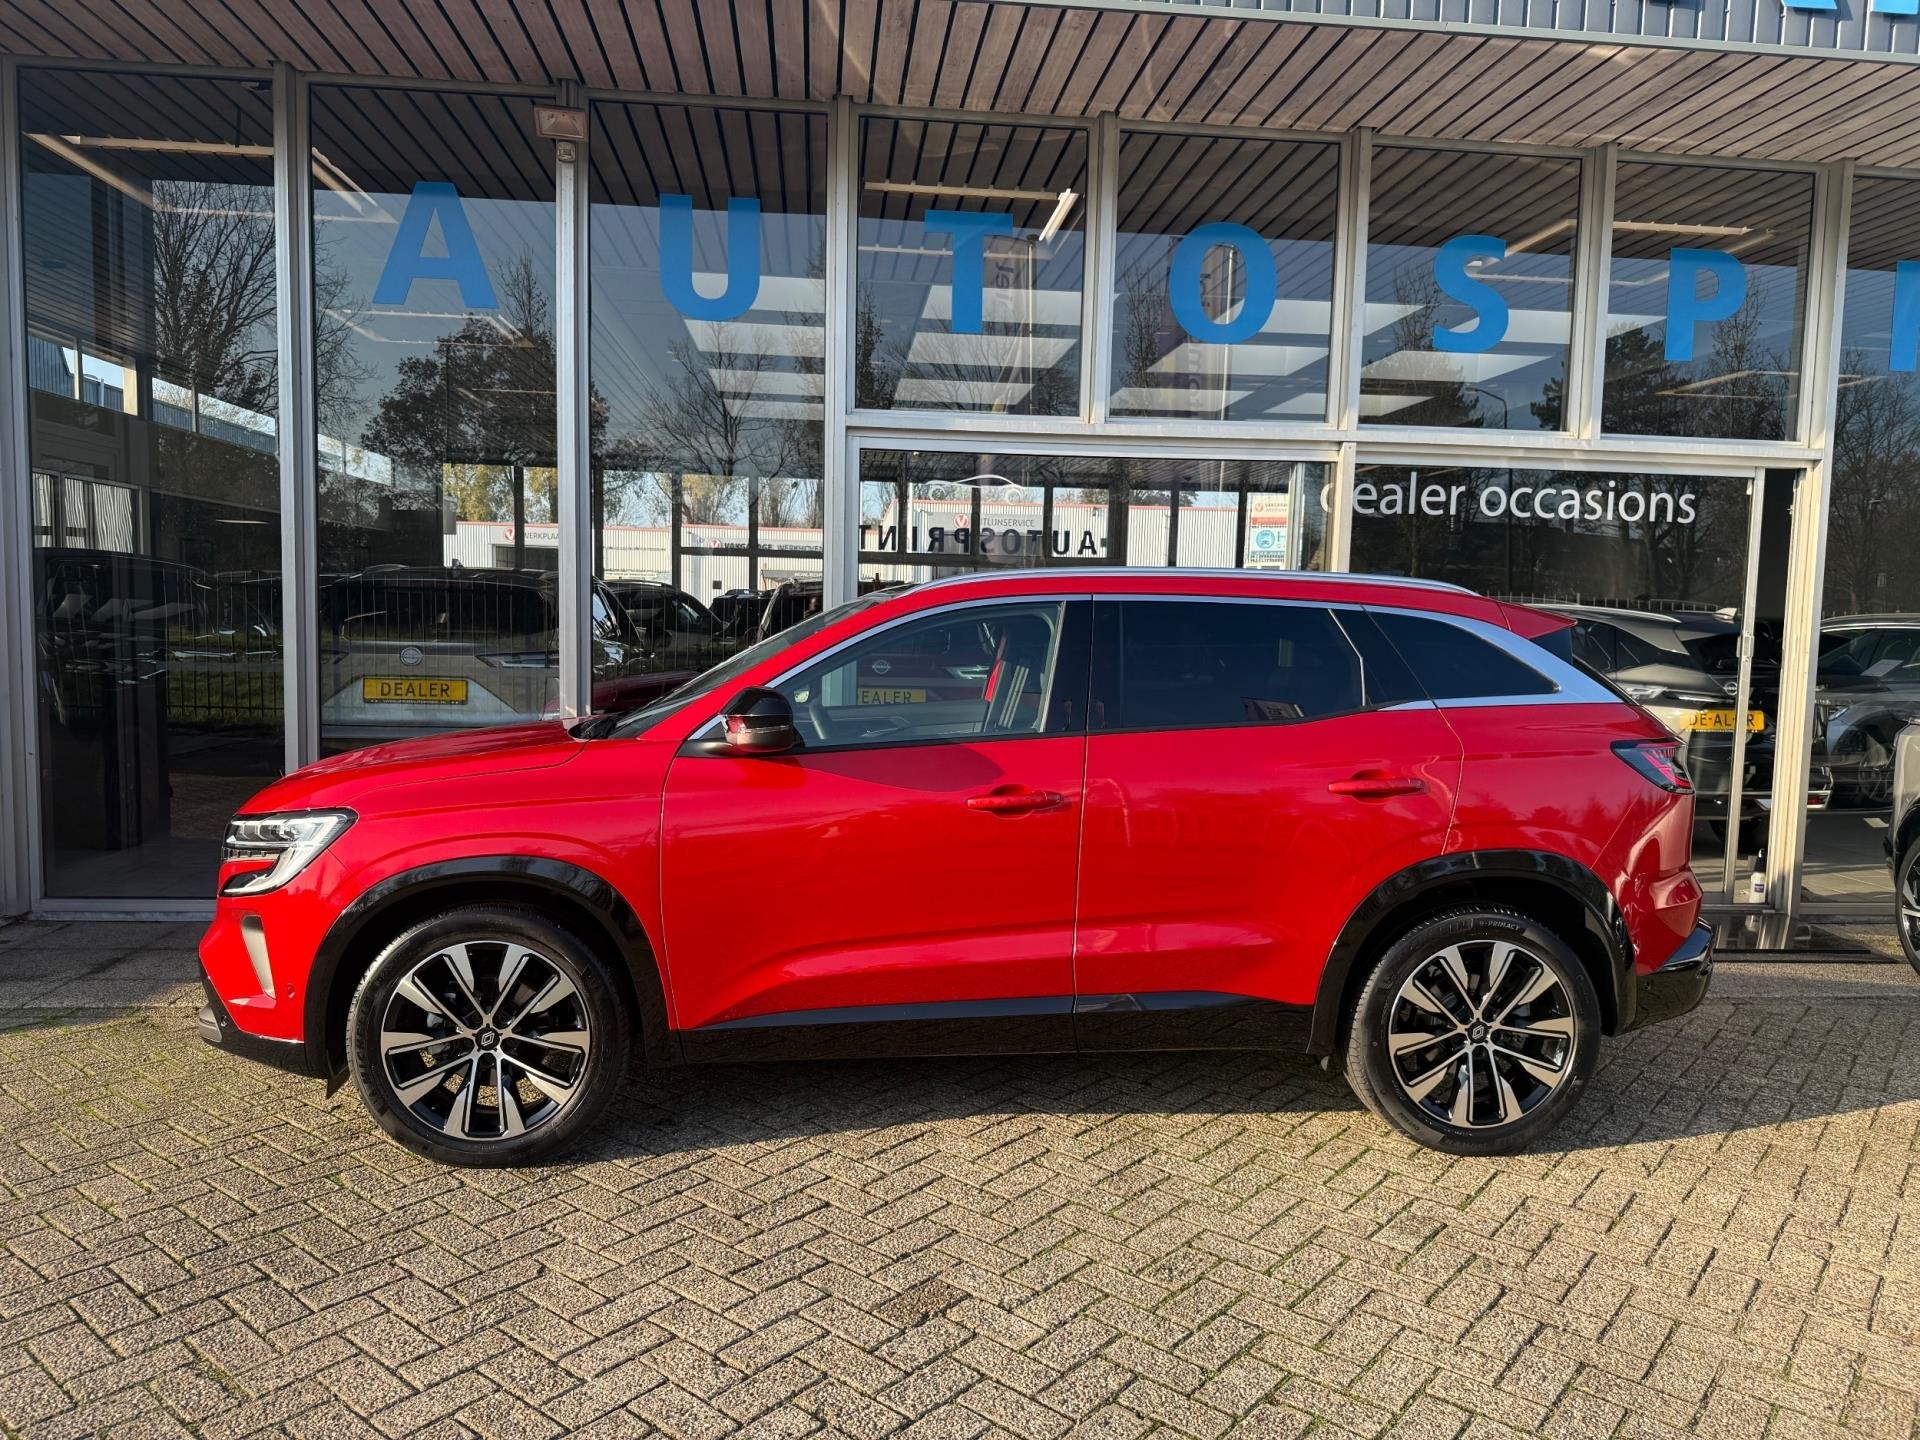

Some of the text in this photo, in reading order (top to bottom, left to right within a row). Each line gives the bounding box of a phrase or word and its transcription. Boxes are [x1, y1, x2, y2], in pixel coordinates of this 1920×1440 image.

[1479, 480, 1696, 523] occasions
[380, 682, 450, 698] DEALER
[858, 690, 912, 704] EALER
[1690, 713, 1755, 727] DE-AL-R
